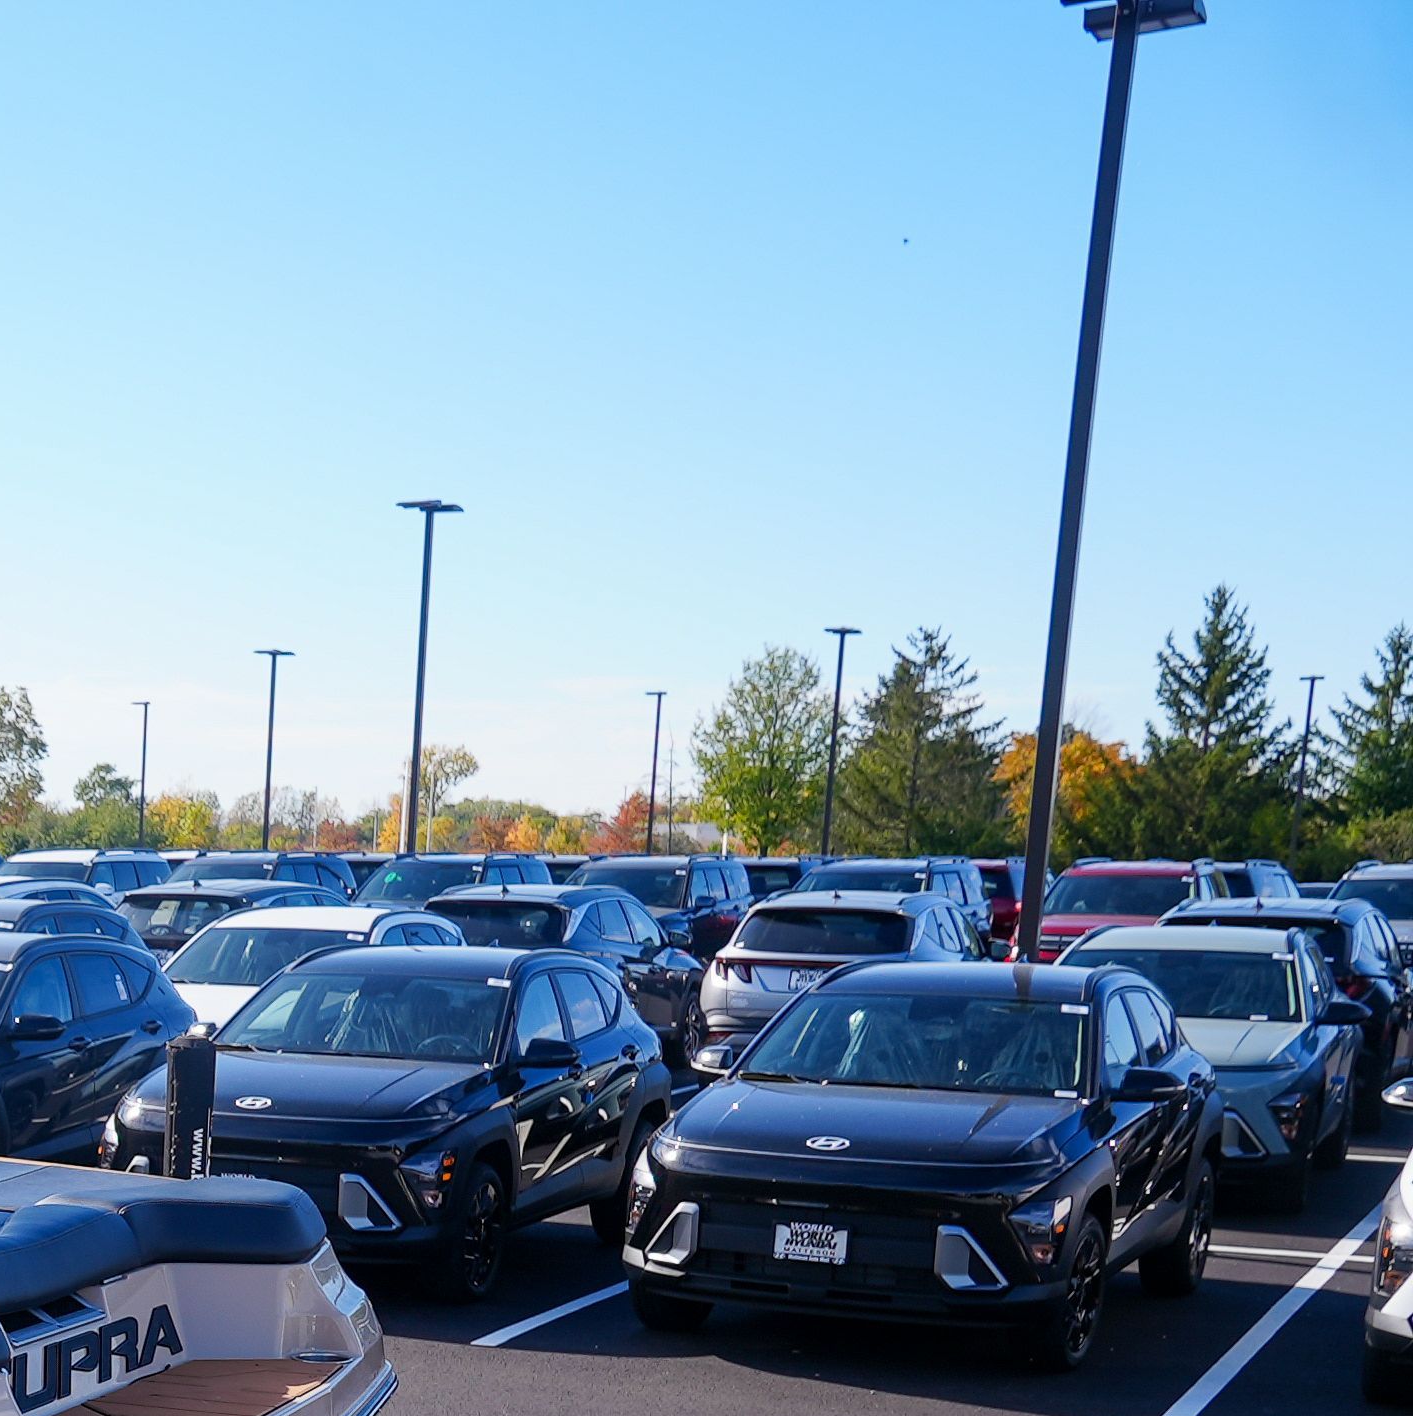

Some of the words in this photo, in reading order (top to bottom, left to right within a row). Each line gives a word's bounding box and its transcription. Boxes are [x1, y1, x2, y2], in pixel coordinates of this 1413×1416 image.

[790, 1221, 834, 1233] WORLD
[790, 1230, 835, 1242] WORLD
[11, 1304, 184, 1414] UPRA
